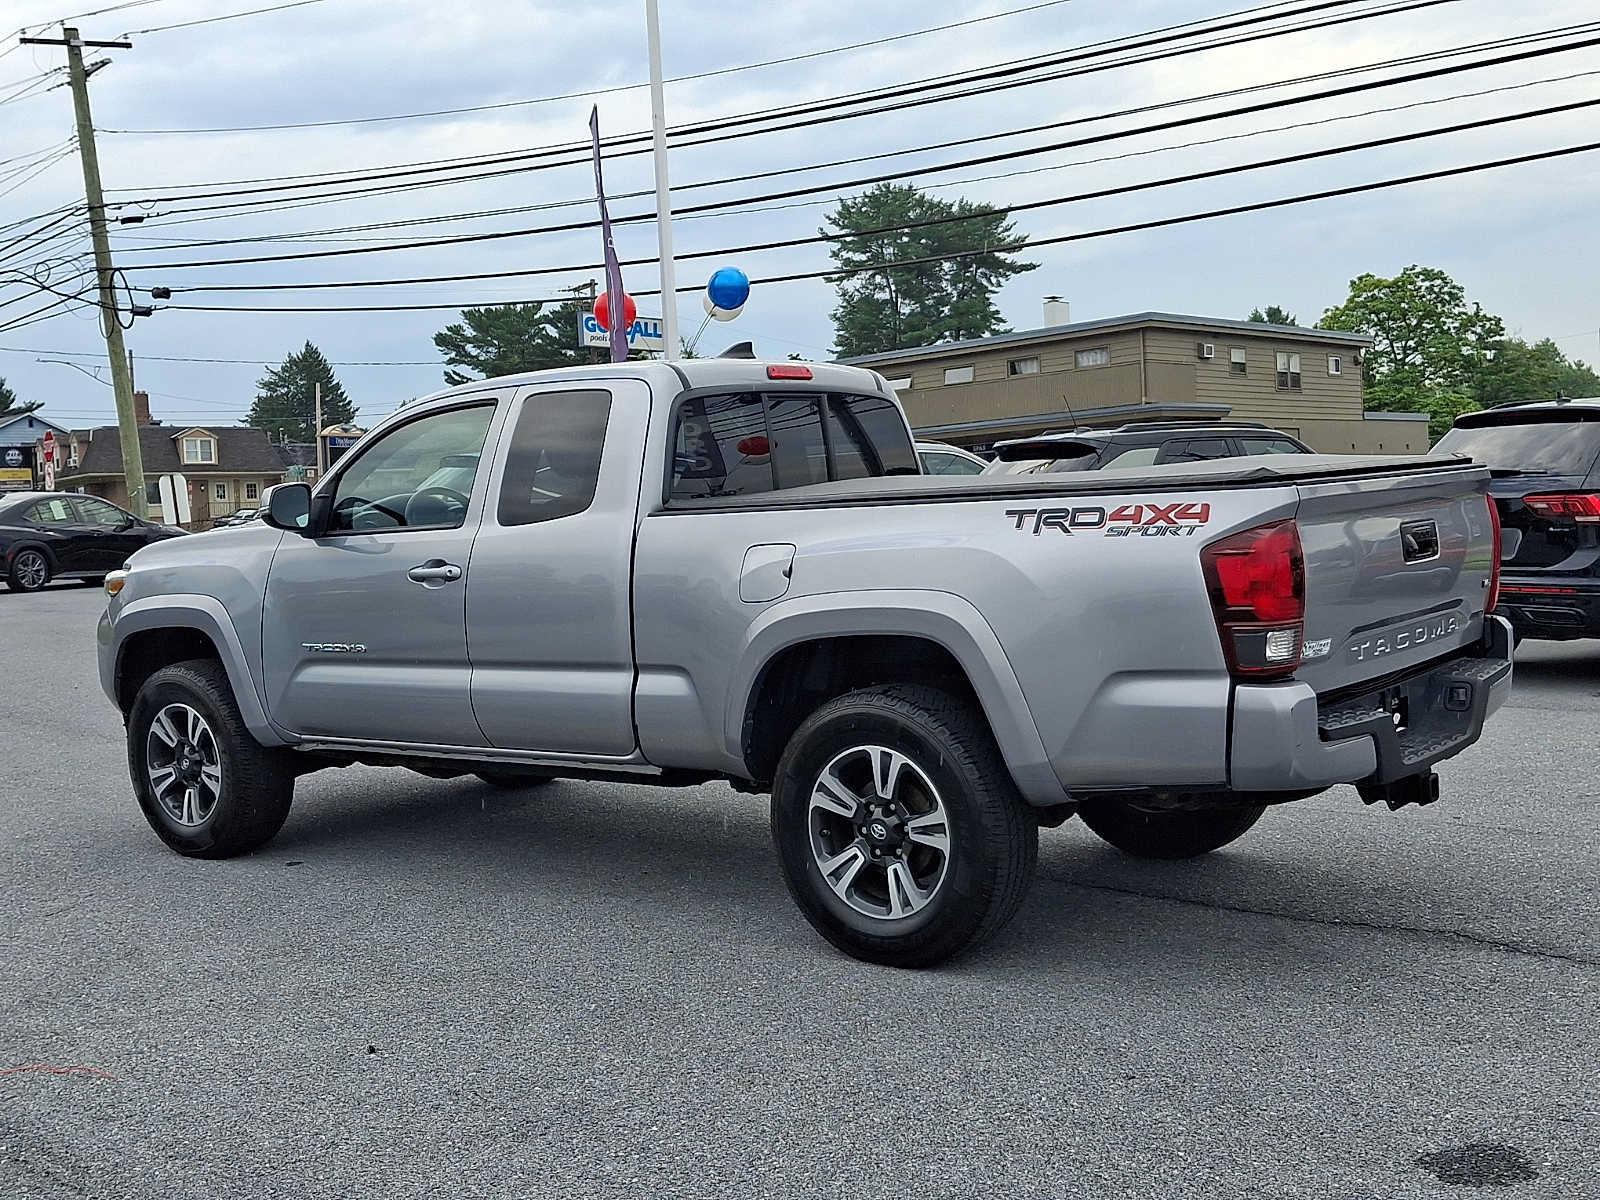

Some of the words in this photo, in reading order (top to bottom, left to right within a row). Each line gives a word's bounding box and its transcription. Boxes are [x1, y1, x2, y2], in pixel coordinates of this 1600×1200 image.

[1005, 506, 1107, 537] TRD
[1104, 524, 1205, 537] SPORT
[302, 642, 366, 653] TACOMA
[1351, 617, 1460, 660] TACOMA
